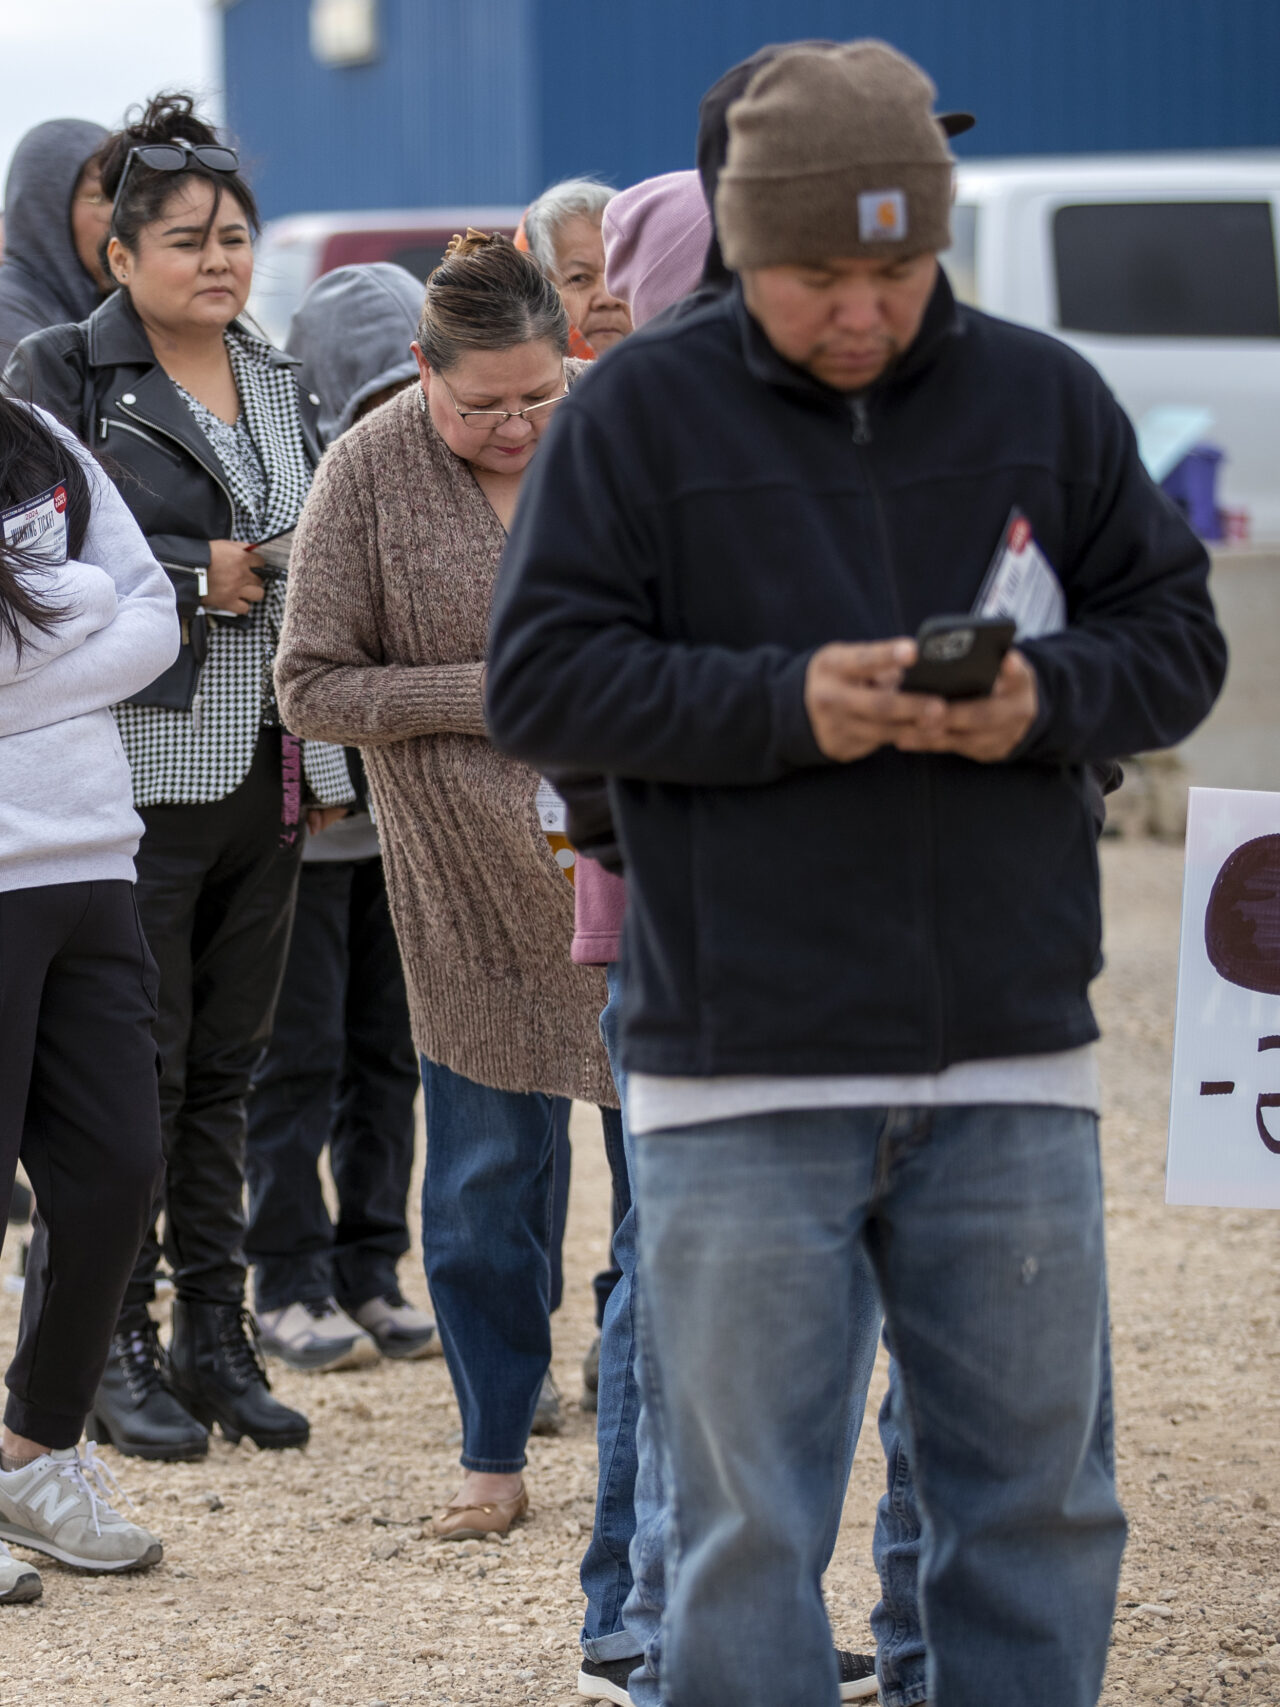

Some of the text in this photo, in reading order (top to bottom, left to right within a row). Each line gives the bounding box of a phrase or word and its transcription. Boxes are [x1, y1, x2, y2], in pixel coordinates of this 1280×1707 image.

[25, 509, 39, 520] 2024
[37, 511, 55, 534] TICKET
[281, 735, 300, 781] LOVE
[28, 1481, 80, 1525] N
